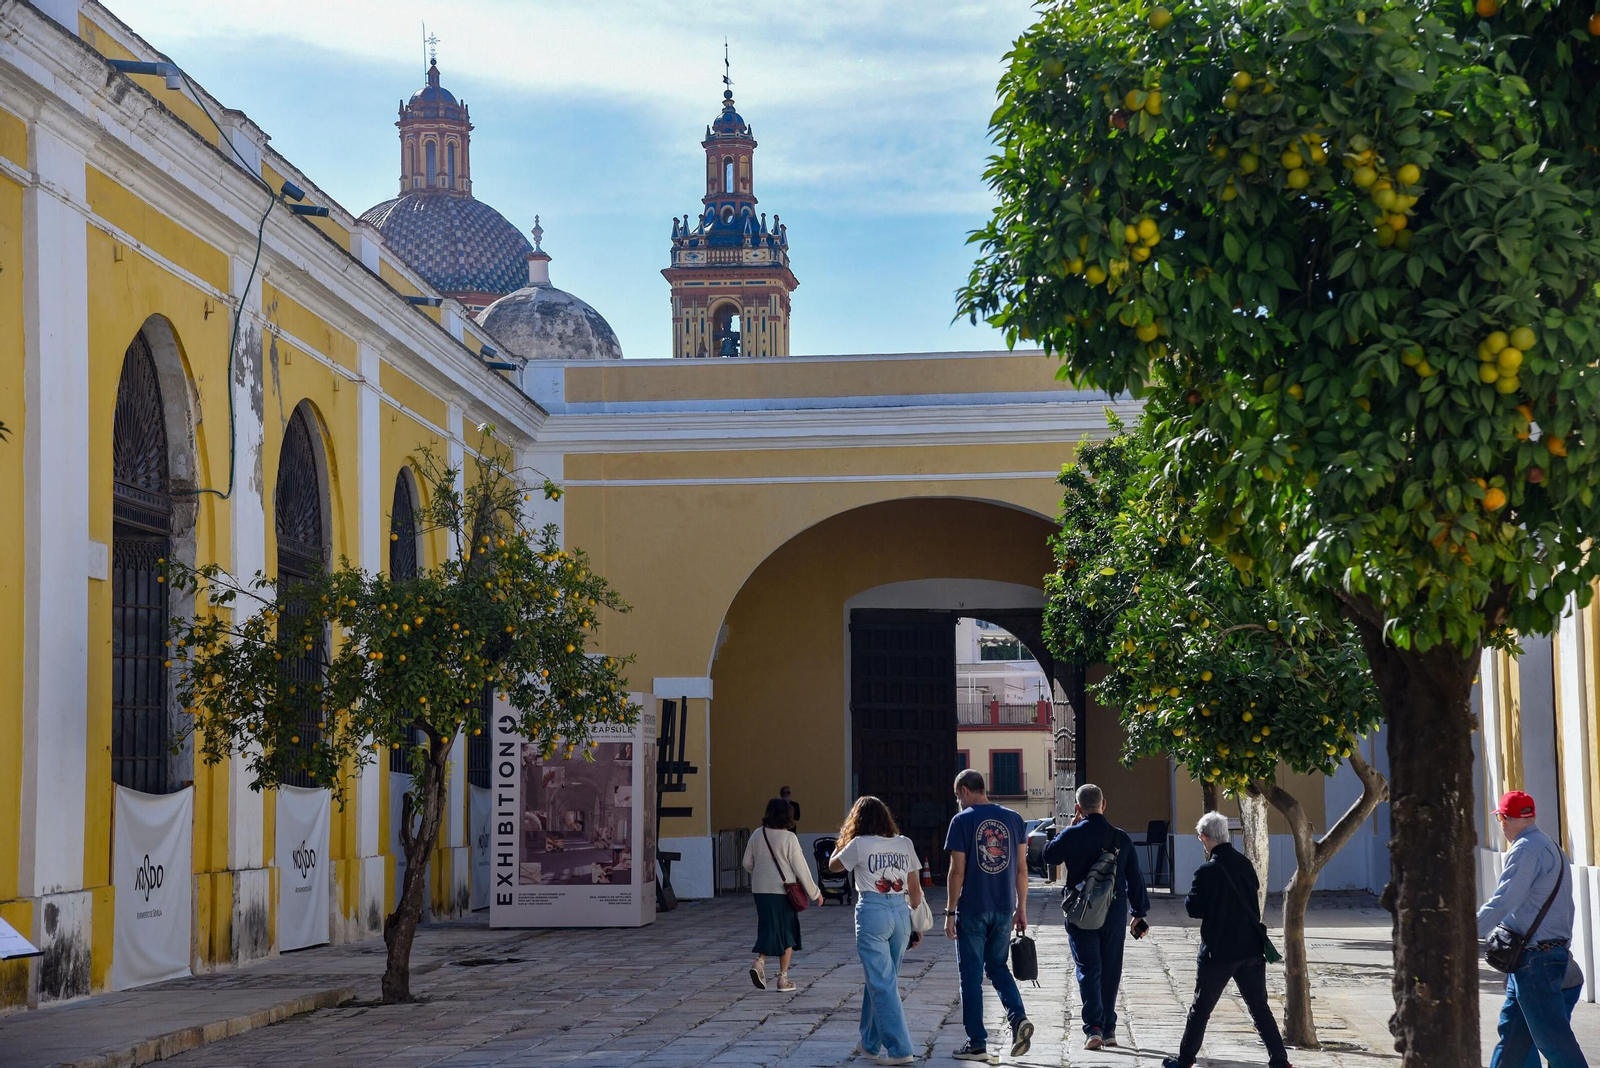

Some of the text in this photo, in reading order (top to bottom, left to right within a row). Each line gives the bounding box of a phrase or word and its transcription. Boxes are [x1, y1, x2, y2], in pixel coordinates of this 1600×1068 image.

[591, 726, 632, 734] CAPSULE
[497, 742, 515, 906] EXHIBITION
[996, 822, 1008, 839] LOCALS
[868, 853, 909, 874] CHERRIES
[993, 860, 1007, 871] HOUSE
